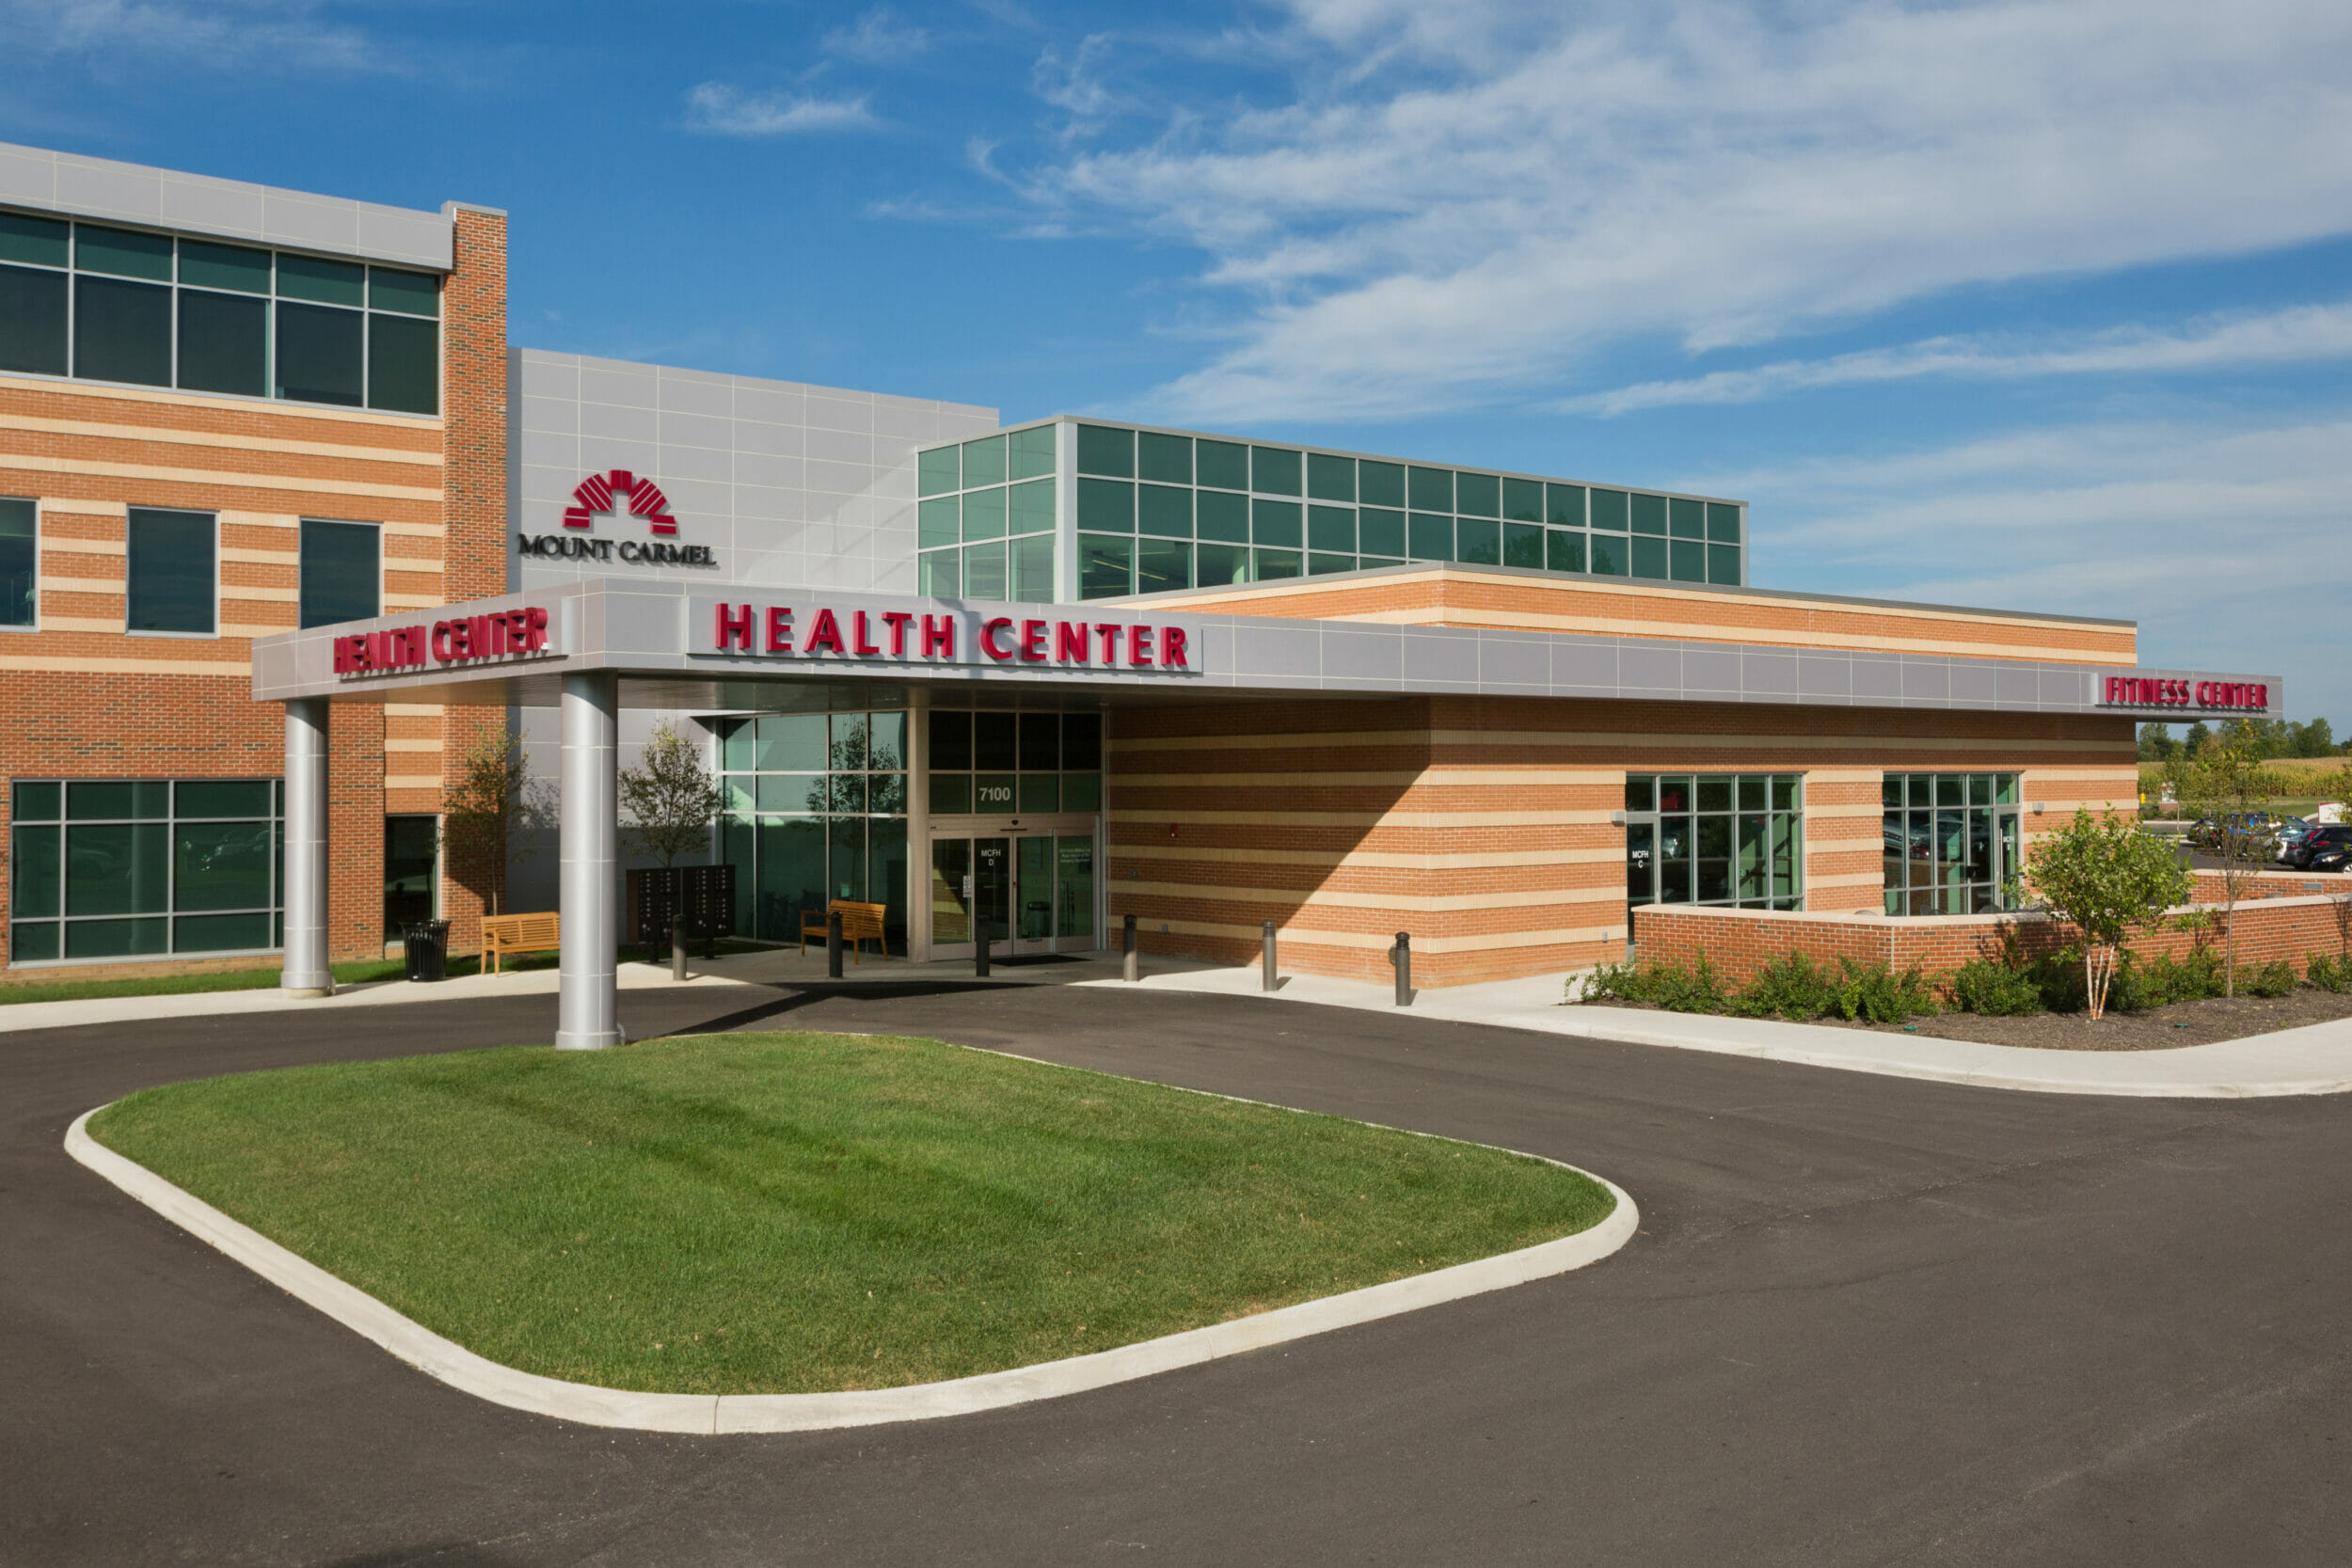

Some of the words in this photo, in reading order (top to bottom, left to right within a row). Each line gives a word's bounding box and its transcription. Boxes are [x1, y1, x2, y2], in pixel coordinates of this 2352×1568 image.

[518, 533, 614, 560] MOUNT
[618, 541, 717, 565] CARMEL
[333, 625, 427, 674] HEALTH
[432, 607, 548, 662] CENTER
[715, 603, 955, 657] HEALTH
[980, 616, 1188, 666] CENTER
[2105, 676, 2190, 705] FITNESS
[2195, 681, 2268, 707] CENTER
[978, 786, 1011, 801] 7100
[980, 848, 1002, 858] MCFH
[1631, 849, 1649, 859] MCFH
[1637, 860, 1644, 869] C
